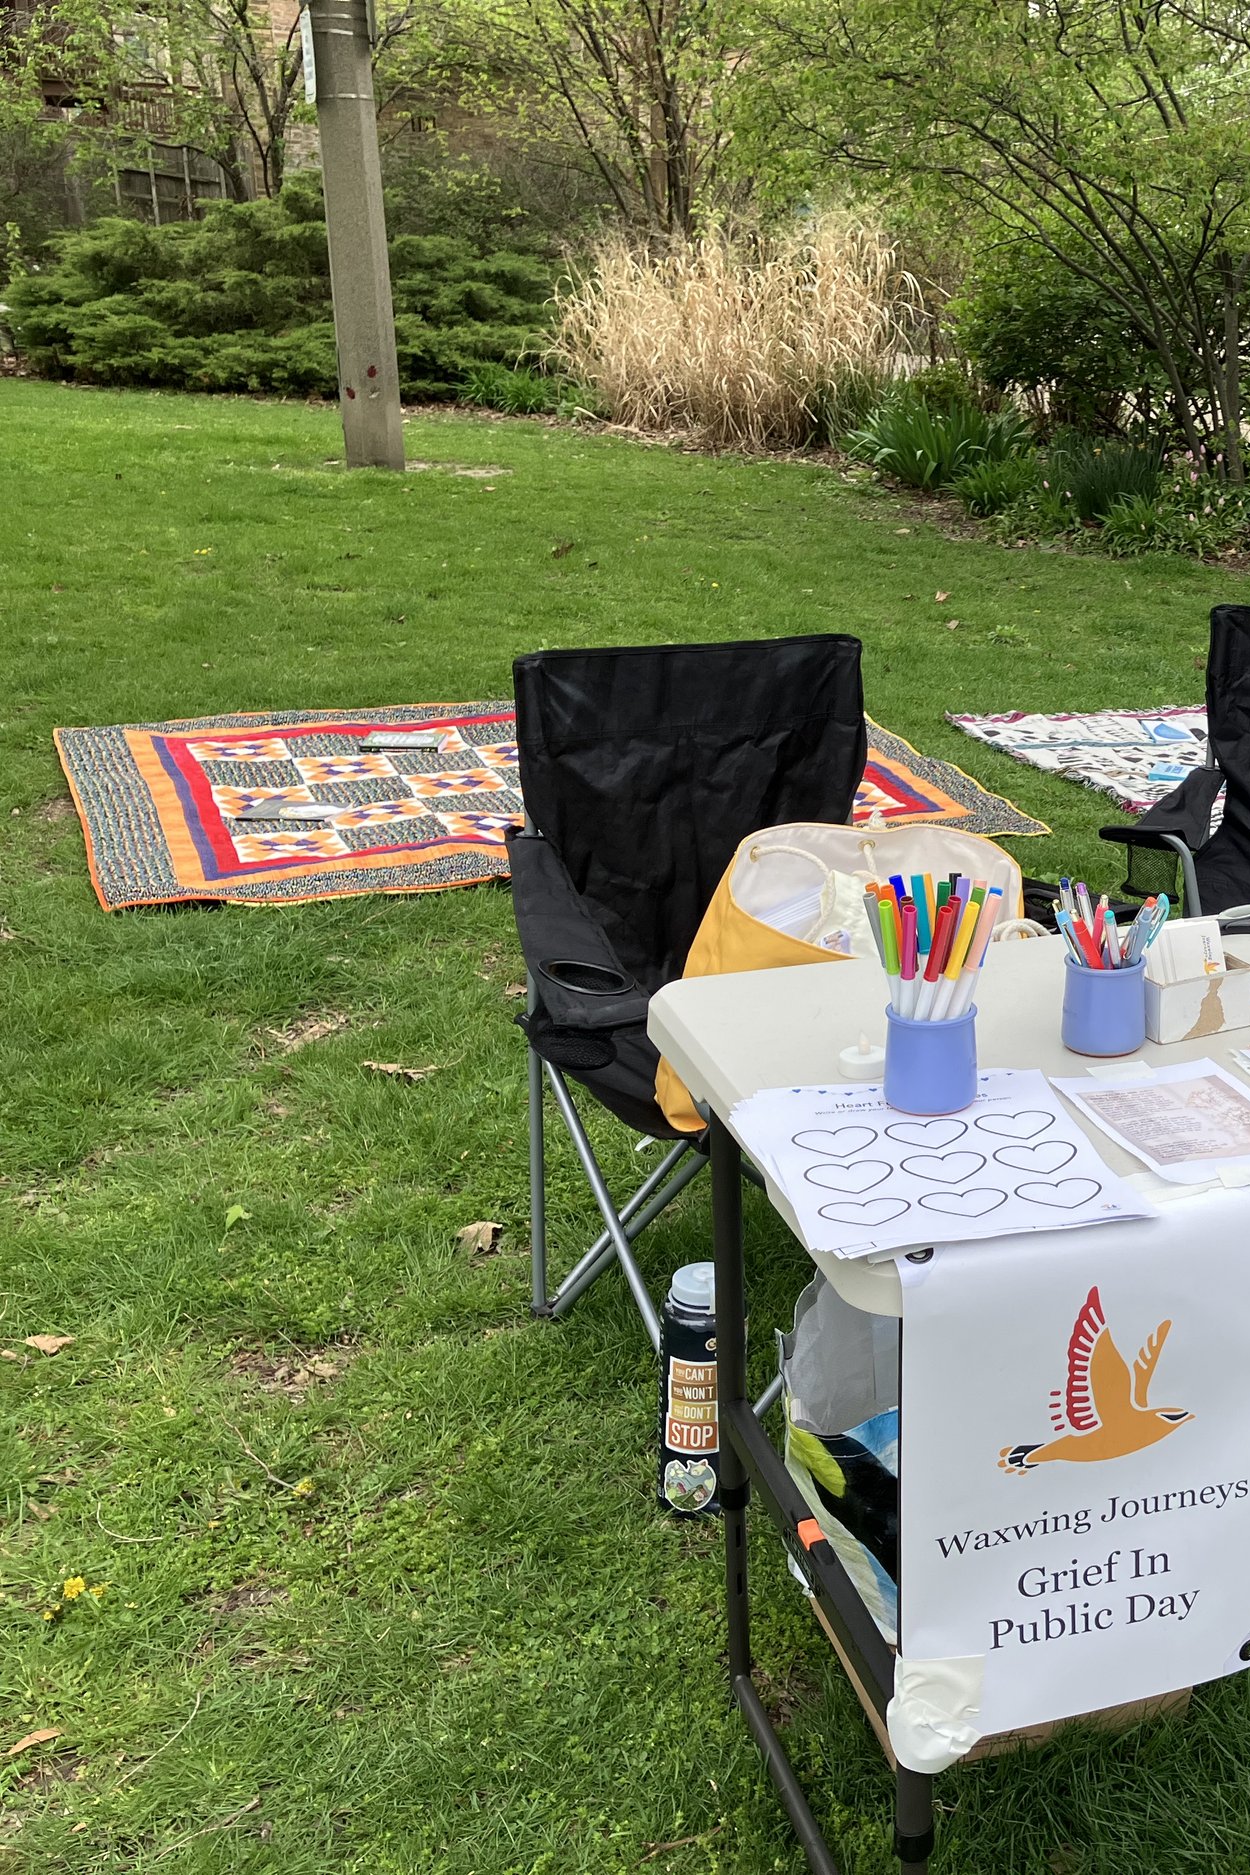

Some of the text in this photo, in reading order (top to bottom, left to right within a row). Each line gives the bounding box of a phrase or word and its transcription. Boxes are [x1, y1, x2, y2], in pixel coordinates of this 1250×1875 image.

[835, 1101, 873, 1109] Heart
[685, 1367, 713, 1381] CAN'T
[683, 1386, 714, 1400] WON'T
[684, 1405, 712, 1419] DON'T
[671, 1422, 714, 1448] STOP
[935, 1478, 1249, 1559] Waxwing Journeys
[1017, 1548, 1171, 1598] Grief In
[989, 1588, 1200, 1650] Public Day
